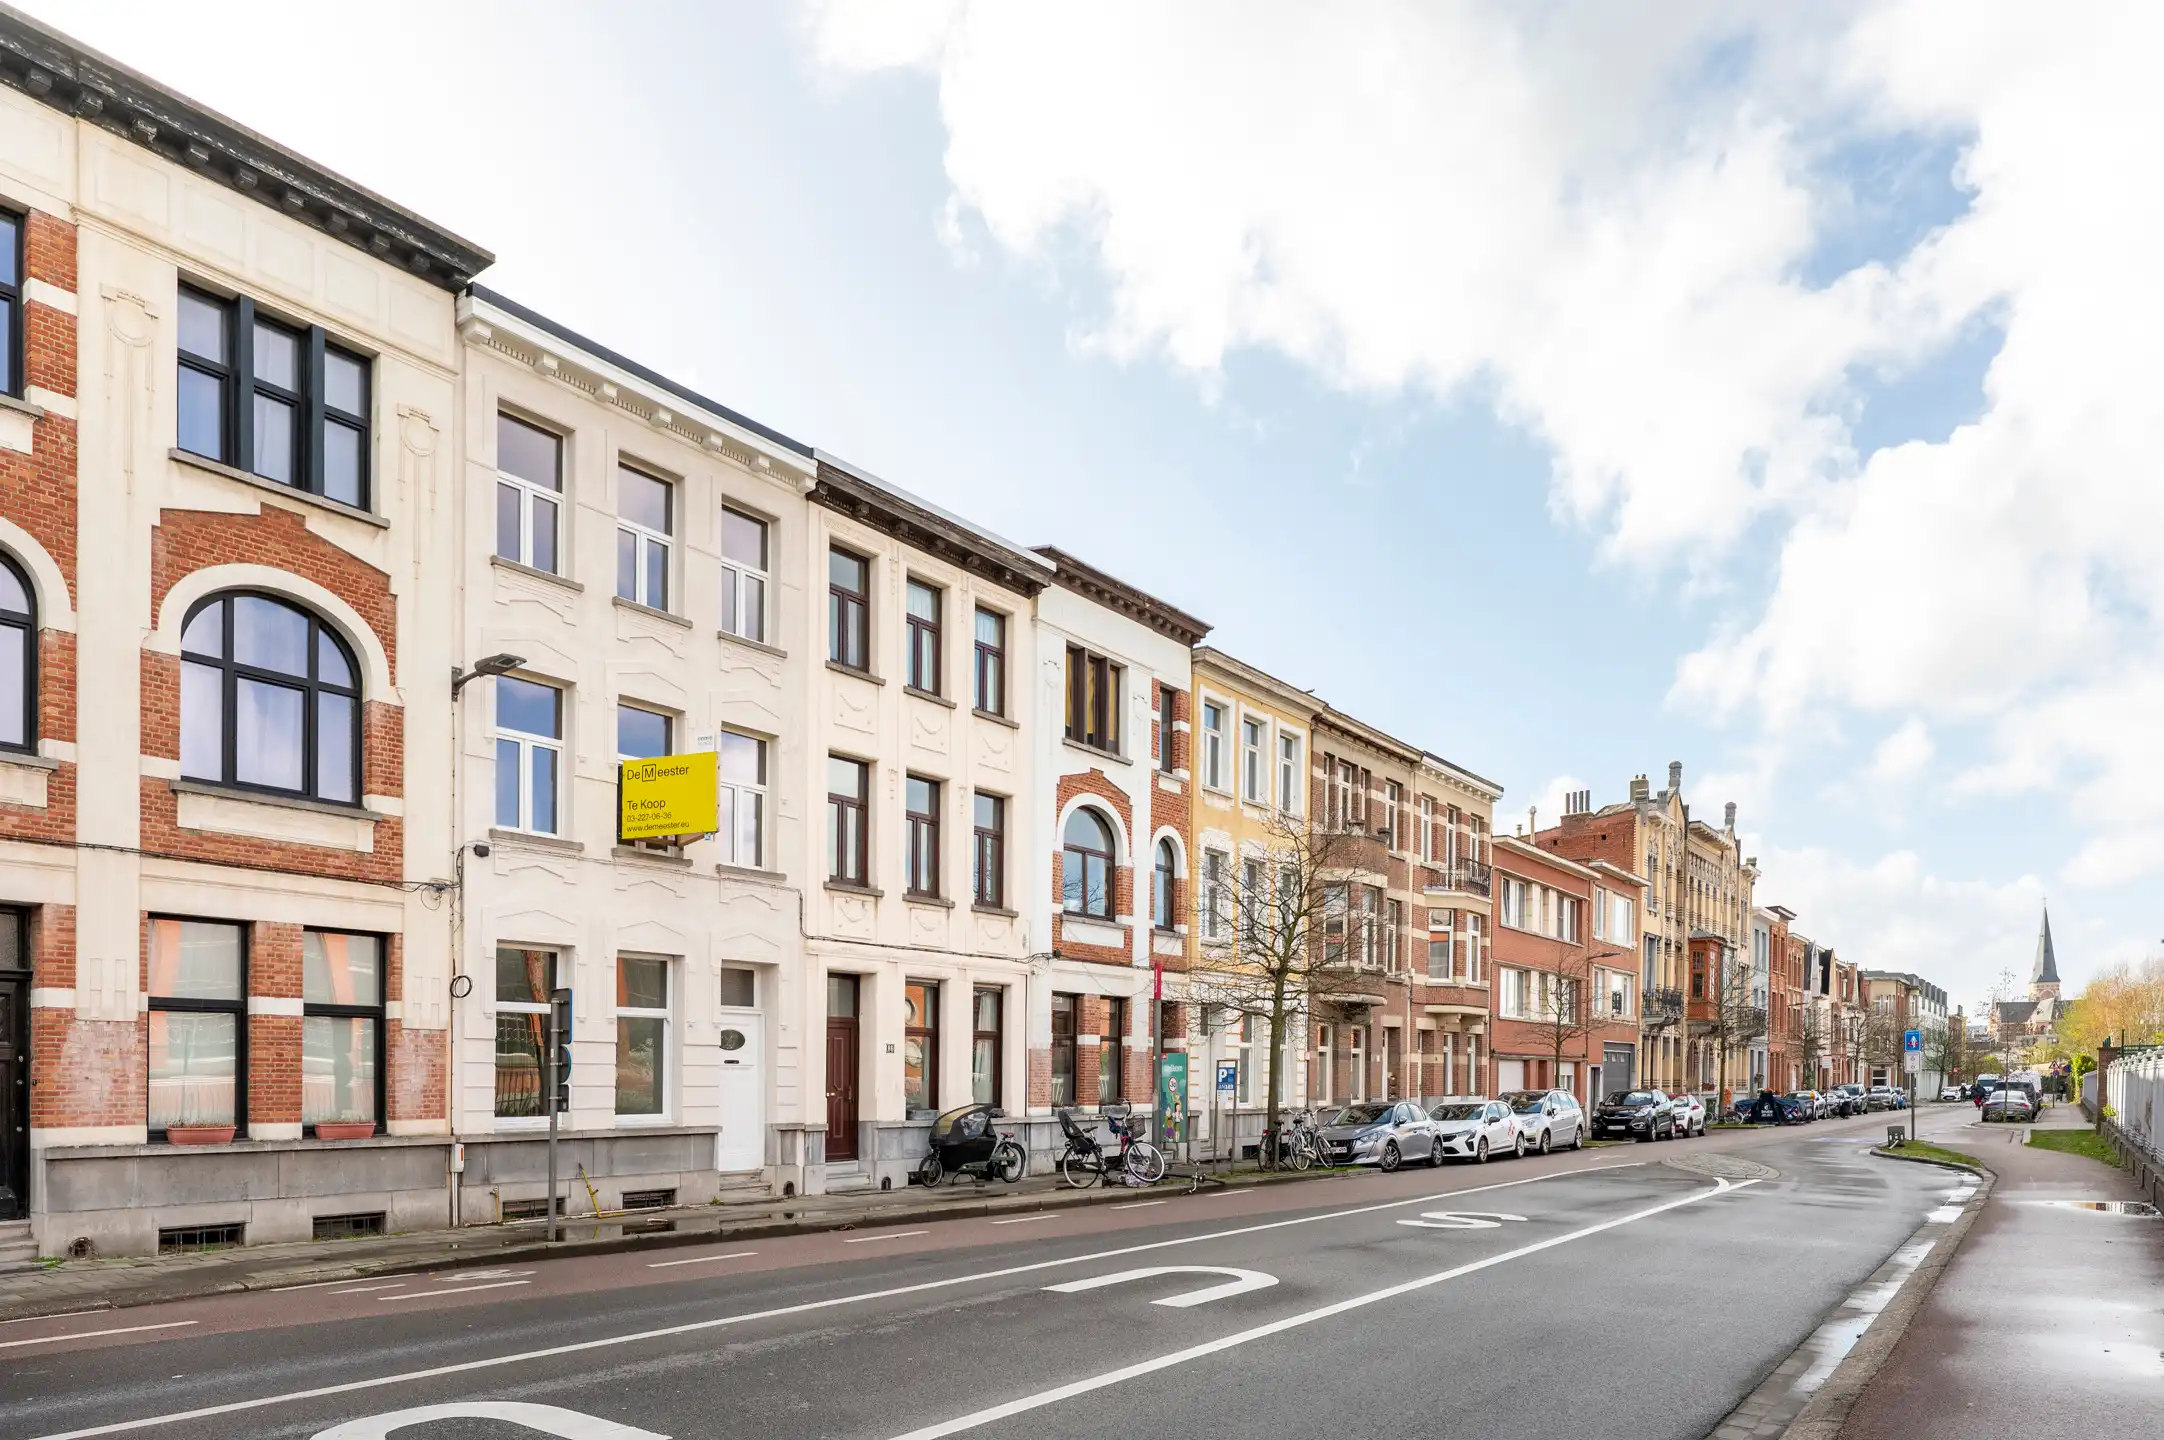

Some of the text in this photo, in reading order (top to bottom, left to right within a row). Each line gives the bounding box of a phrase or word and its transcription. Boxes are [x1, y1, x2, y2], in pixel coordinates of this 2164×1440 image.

[626, 799, 666, 811] Te Koop
[626, 822, 690, 833] www.demeester.eu
[1218, 1068, 1227, 1082] P
